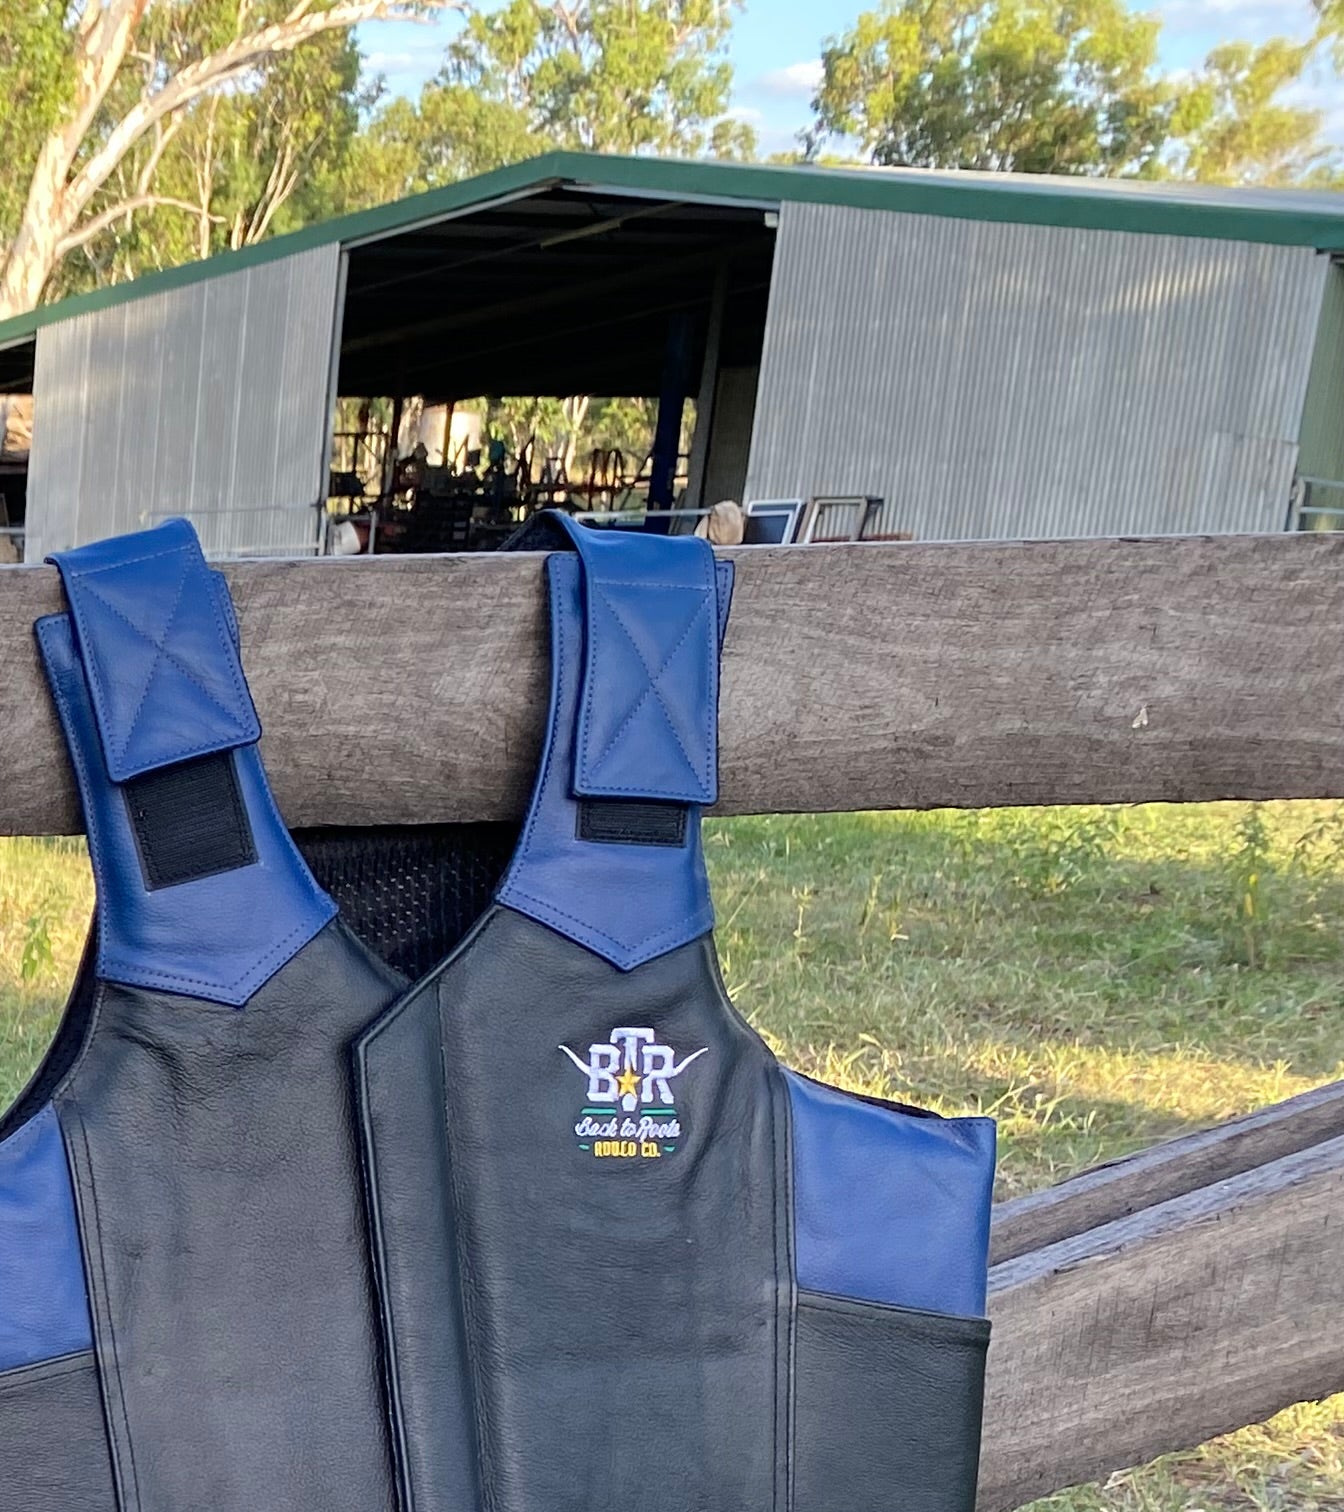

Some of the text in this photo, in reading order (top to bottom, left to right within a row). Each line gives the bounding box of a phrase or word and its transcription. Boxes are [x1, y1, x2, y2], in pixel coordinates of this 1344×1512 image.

[586, 1027, 675, 1112] BTR
[574, 1116, 681, 1143] Back to Roots
[593, 1140, 637, 1157] RODEO
